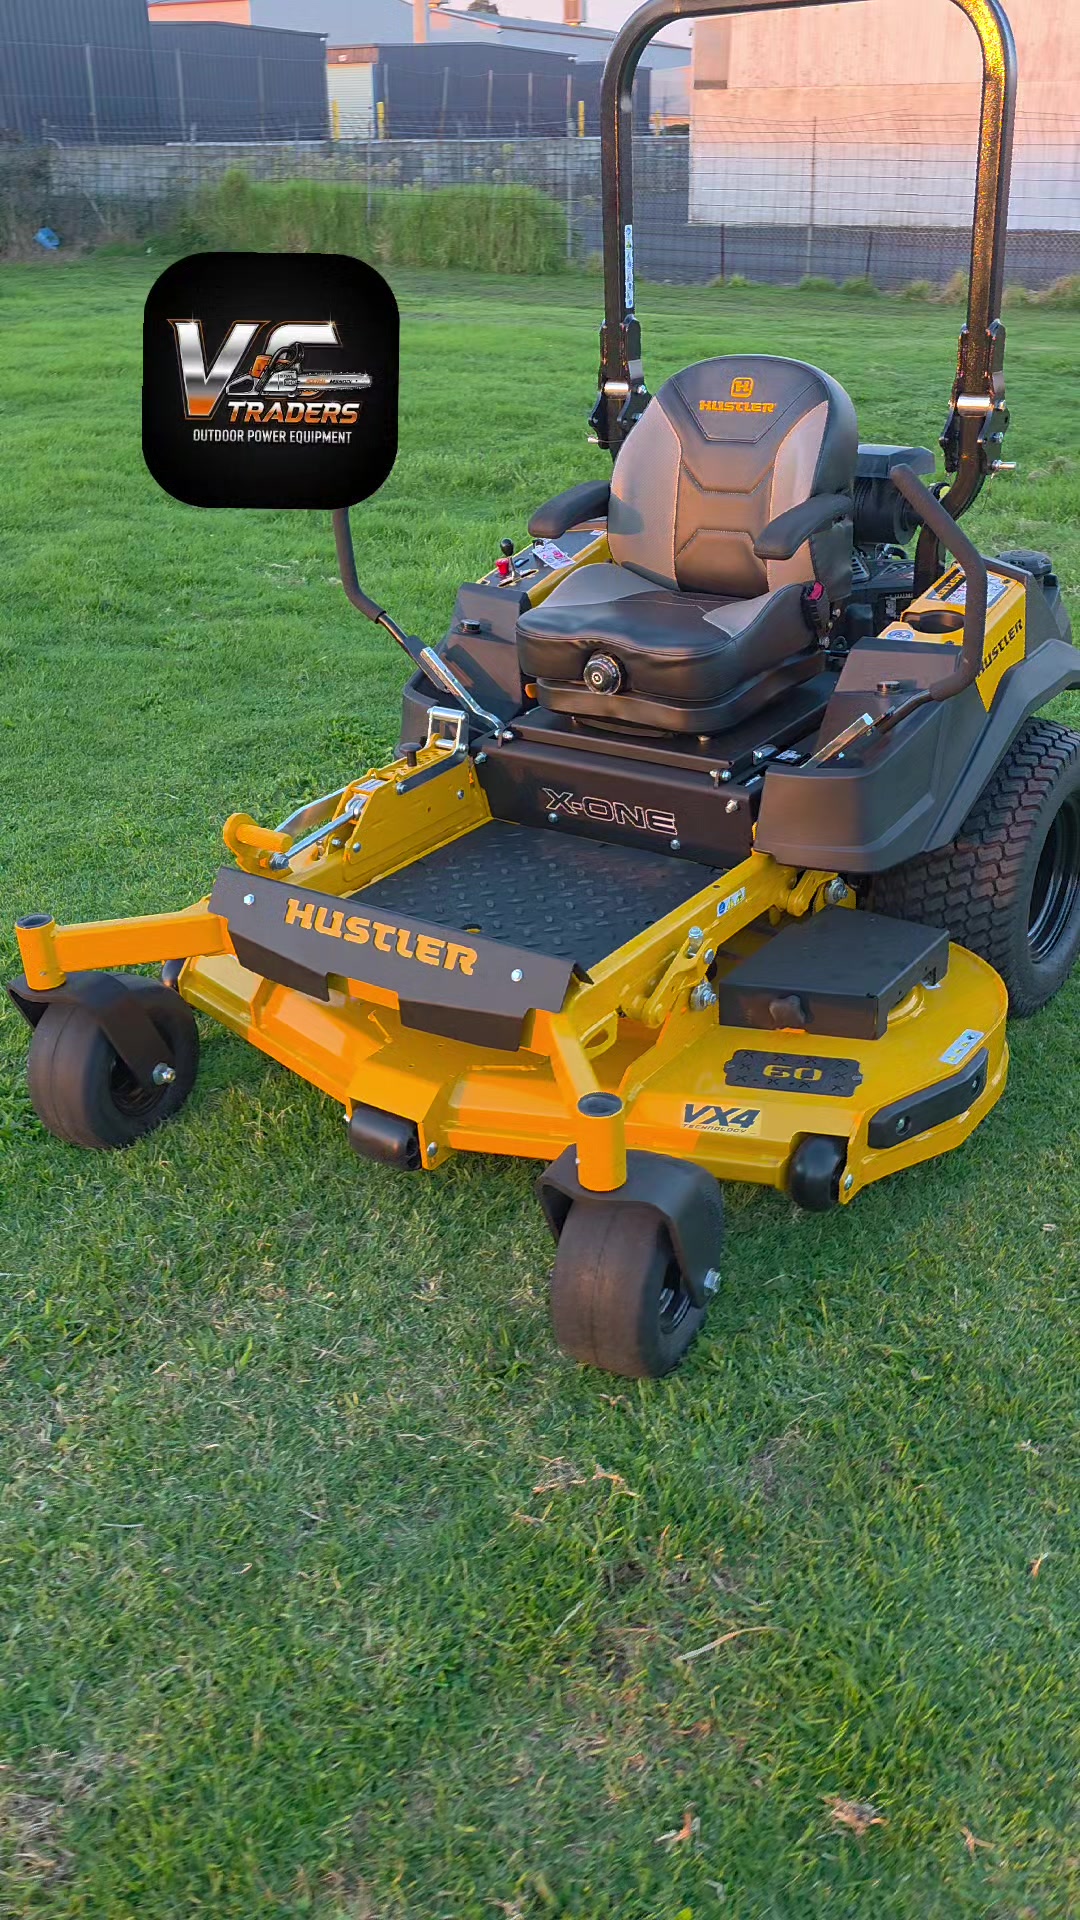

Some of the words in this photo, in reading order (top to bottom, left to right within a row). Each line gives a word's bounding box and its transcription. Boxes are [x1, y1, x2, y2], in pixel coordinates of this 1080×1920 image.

[699, 400, 777, 413] HUSTLER
[976, 618, 1023, 678] USTLER
[542, 787, 678, 836] X-ONE
[284, 898, 478, 976] HUSTLER
[763, 1064, 823, 1081] 60
[684, 1103, 761, 1128] VX4
[682, 1123, 747, 1134] TECHNOLOGY
